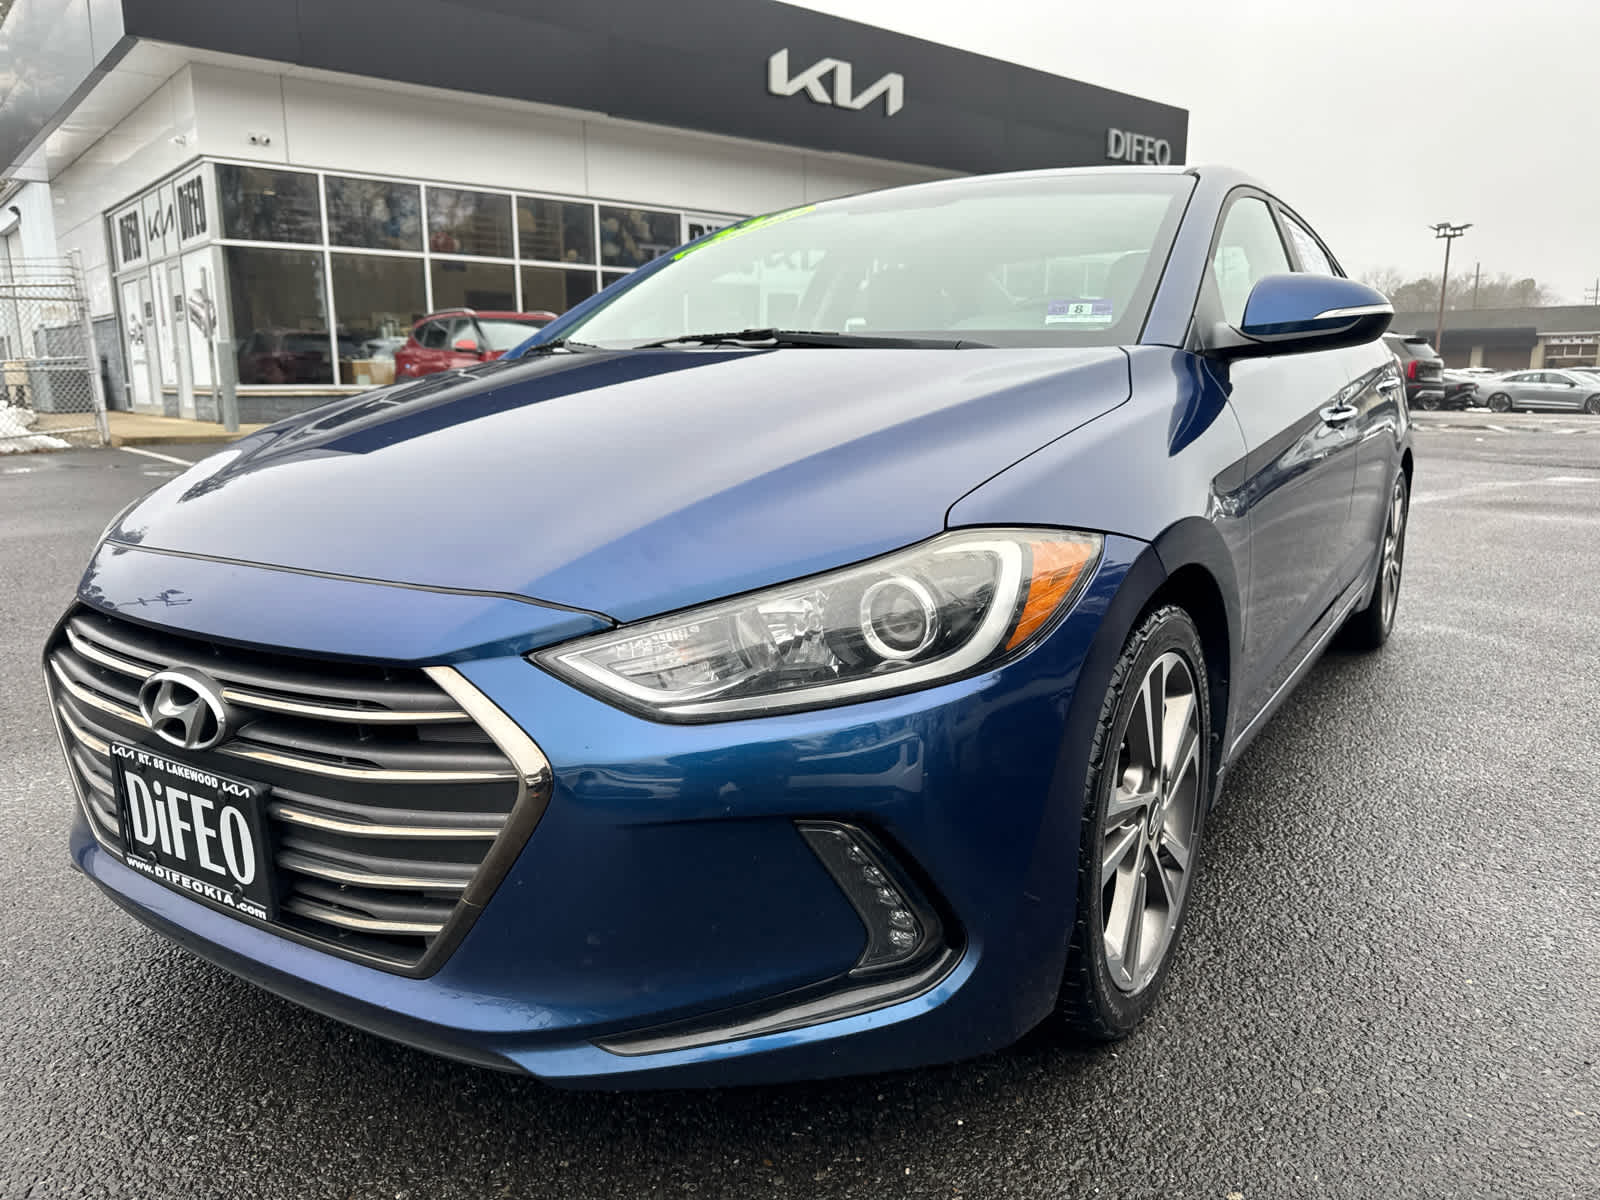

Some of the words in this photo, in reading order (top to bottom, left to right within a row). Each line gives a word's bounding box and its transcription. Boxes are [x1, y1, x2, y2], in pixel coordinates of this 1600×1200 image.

[768, 48, 904, 116] KIA
[1106, 128, 1171, 166] DIFEO
[112, 744, 134, 760] KIA
[138, 753, 152, 766] RT.
[166, 762, 218, 788] LAKEWOOD
[222, 782, 250, 799] KIA
[125, 771, 256, 886] DiFEO
